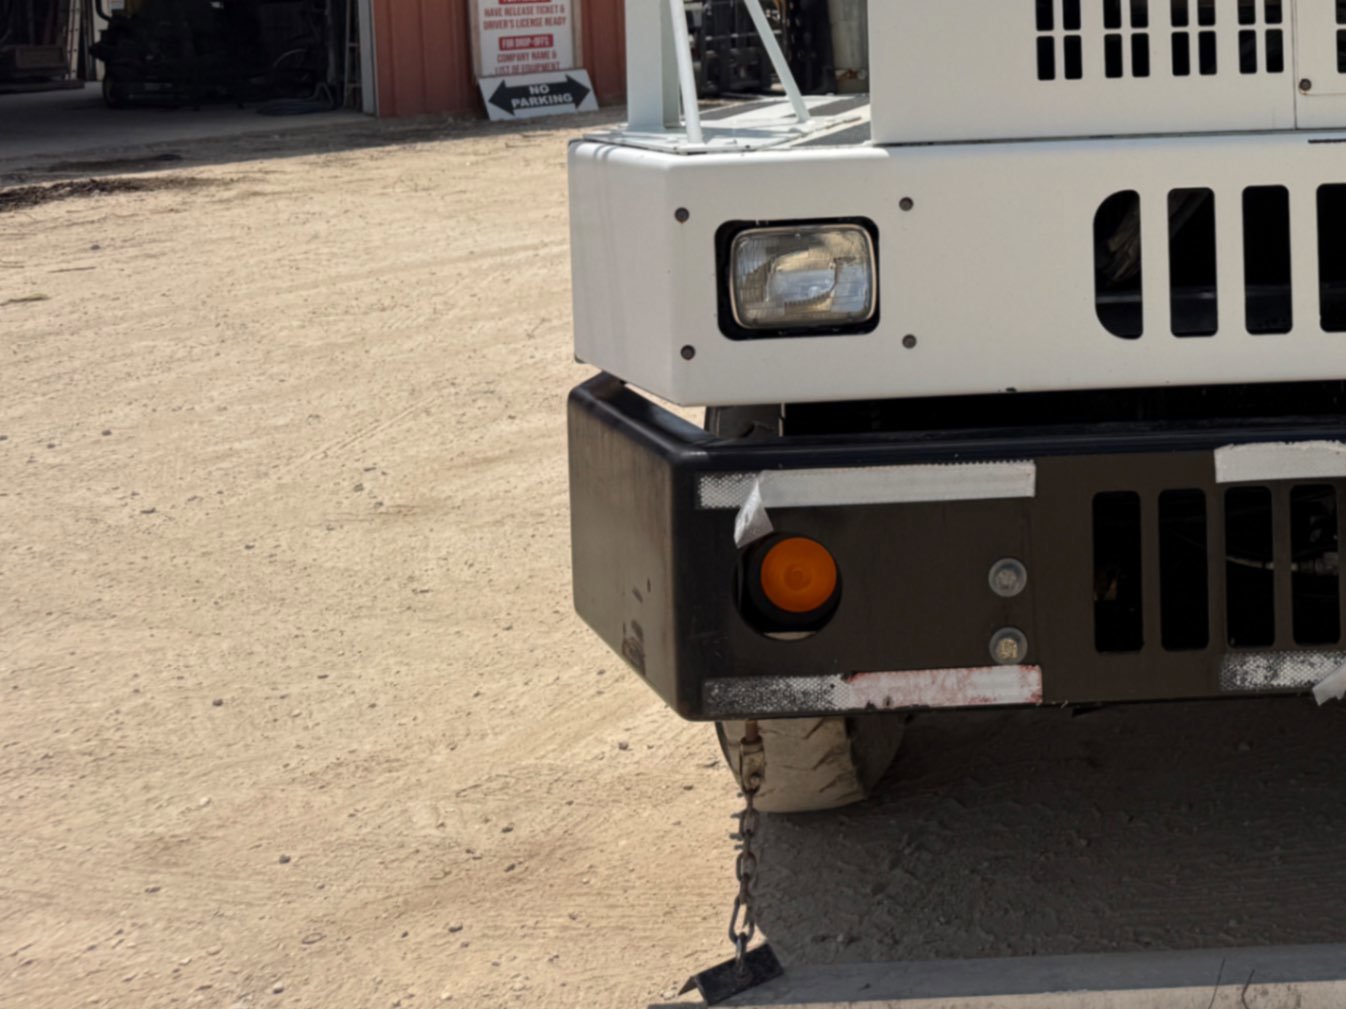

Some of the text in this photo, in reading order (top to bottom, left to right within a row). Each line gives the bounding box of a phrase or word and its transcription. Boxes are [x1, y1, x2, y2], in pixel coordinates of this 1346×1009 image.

[484, 7, 502, 17] HAVE
[504, 6, 534, 16] RELEASE
[536, 5, 559, 15] TICKET
[483, 16, 567, 30] DRIVER'S LICENSE READY
[501, 38, 514, 49] FOR
[497, 52, 529, 63] COMPANY
[531, 51, 550, 61] NAME
[528, 83, 550, 95] NO
[510, 93, 573, 108] PARKING
